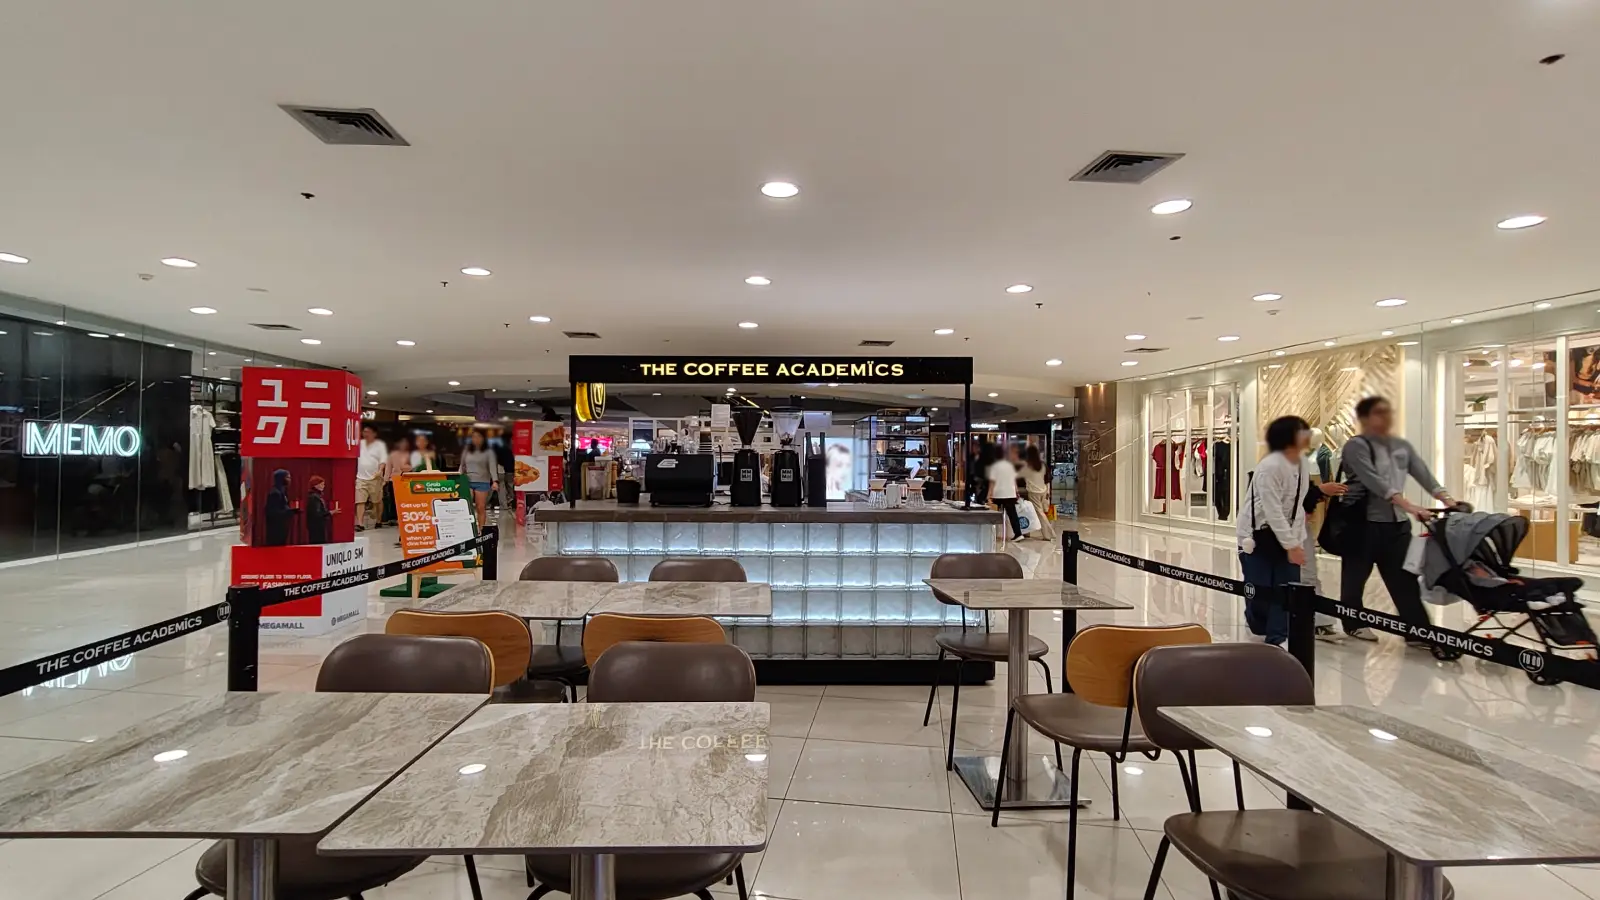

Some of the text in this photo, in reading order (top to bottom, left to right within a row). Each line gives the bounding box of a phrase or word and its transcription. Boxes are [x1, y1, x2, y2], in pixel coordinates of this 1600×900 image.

[640, 361, 904, 376] THE COFFEE ACADEMÏCS
[346, 383, 360, 414] UNI
[26, 421, 140, 457] MEMO
[346, 418, 360, 451] QLO
[402, 511, 432, 522] 30%
[404, 522, 431, 533] OFF
[326, 547, 364, 567] UNIQLO SM
[1082, 544, 1090, 552] THE
[1090, 546, 1106, 557] COFFEE
[401, 560, 412, 570] THE
[411, 555, 431, 567] COFFEE
[1159, 564, 1171, 575] THE
[1171, 568, 1194, 582] COFFEE
[284, 587, 300, 597] THE
[301, 580, 330, 594] COFFEE
[1335, 604, 1358, 619] THE
[1359, 611, 1407, 633] COFFEE
[36, 654, 71, 675] THE
[73, 637, 131, 664] COFFEE
